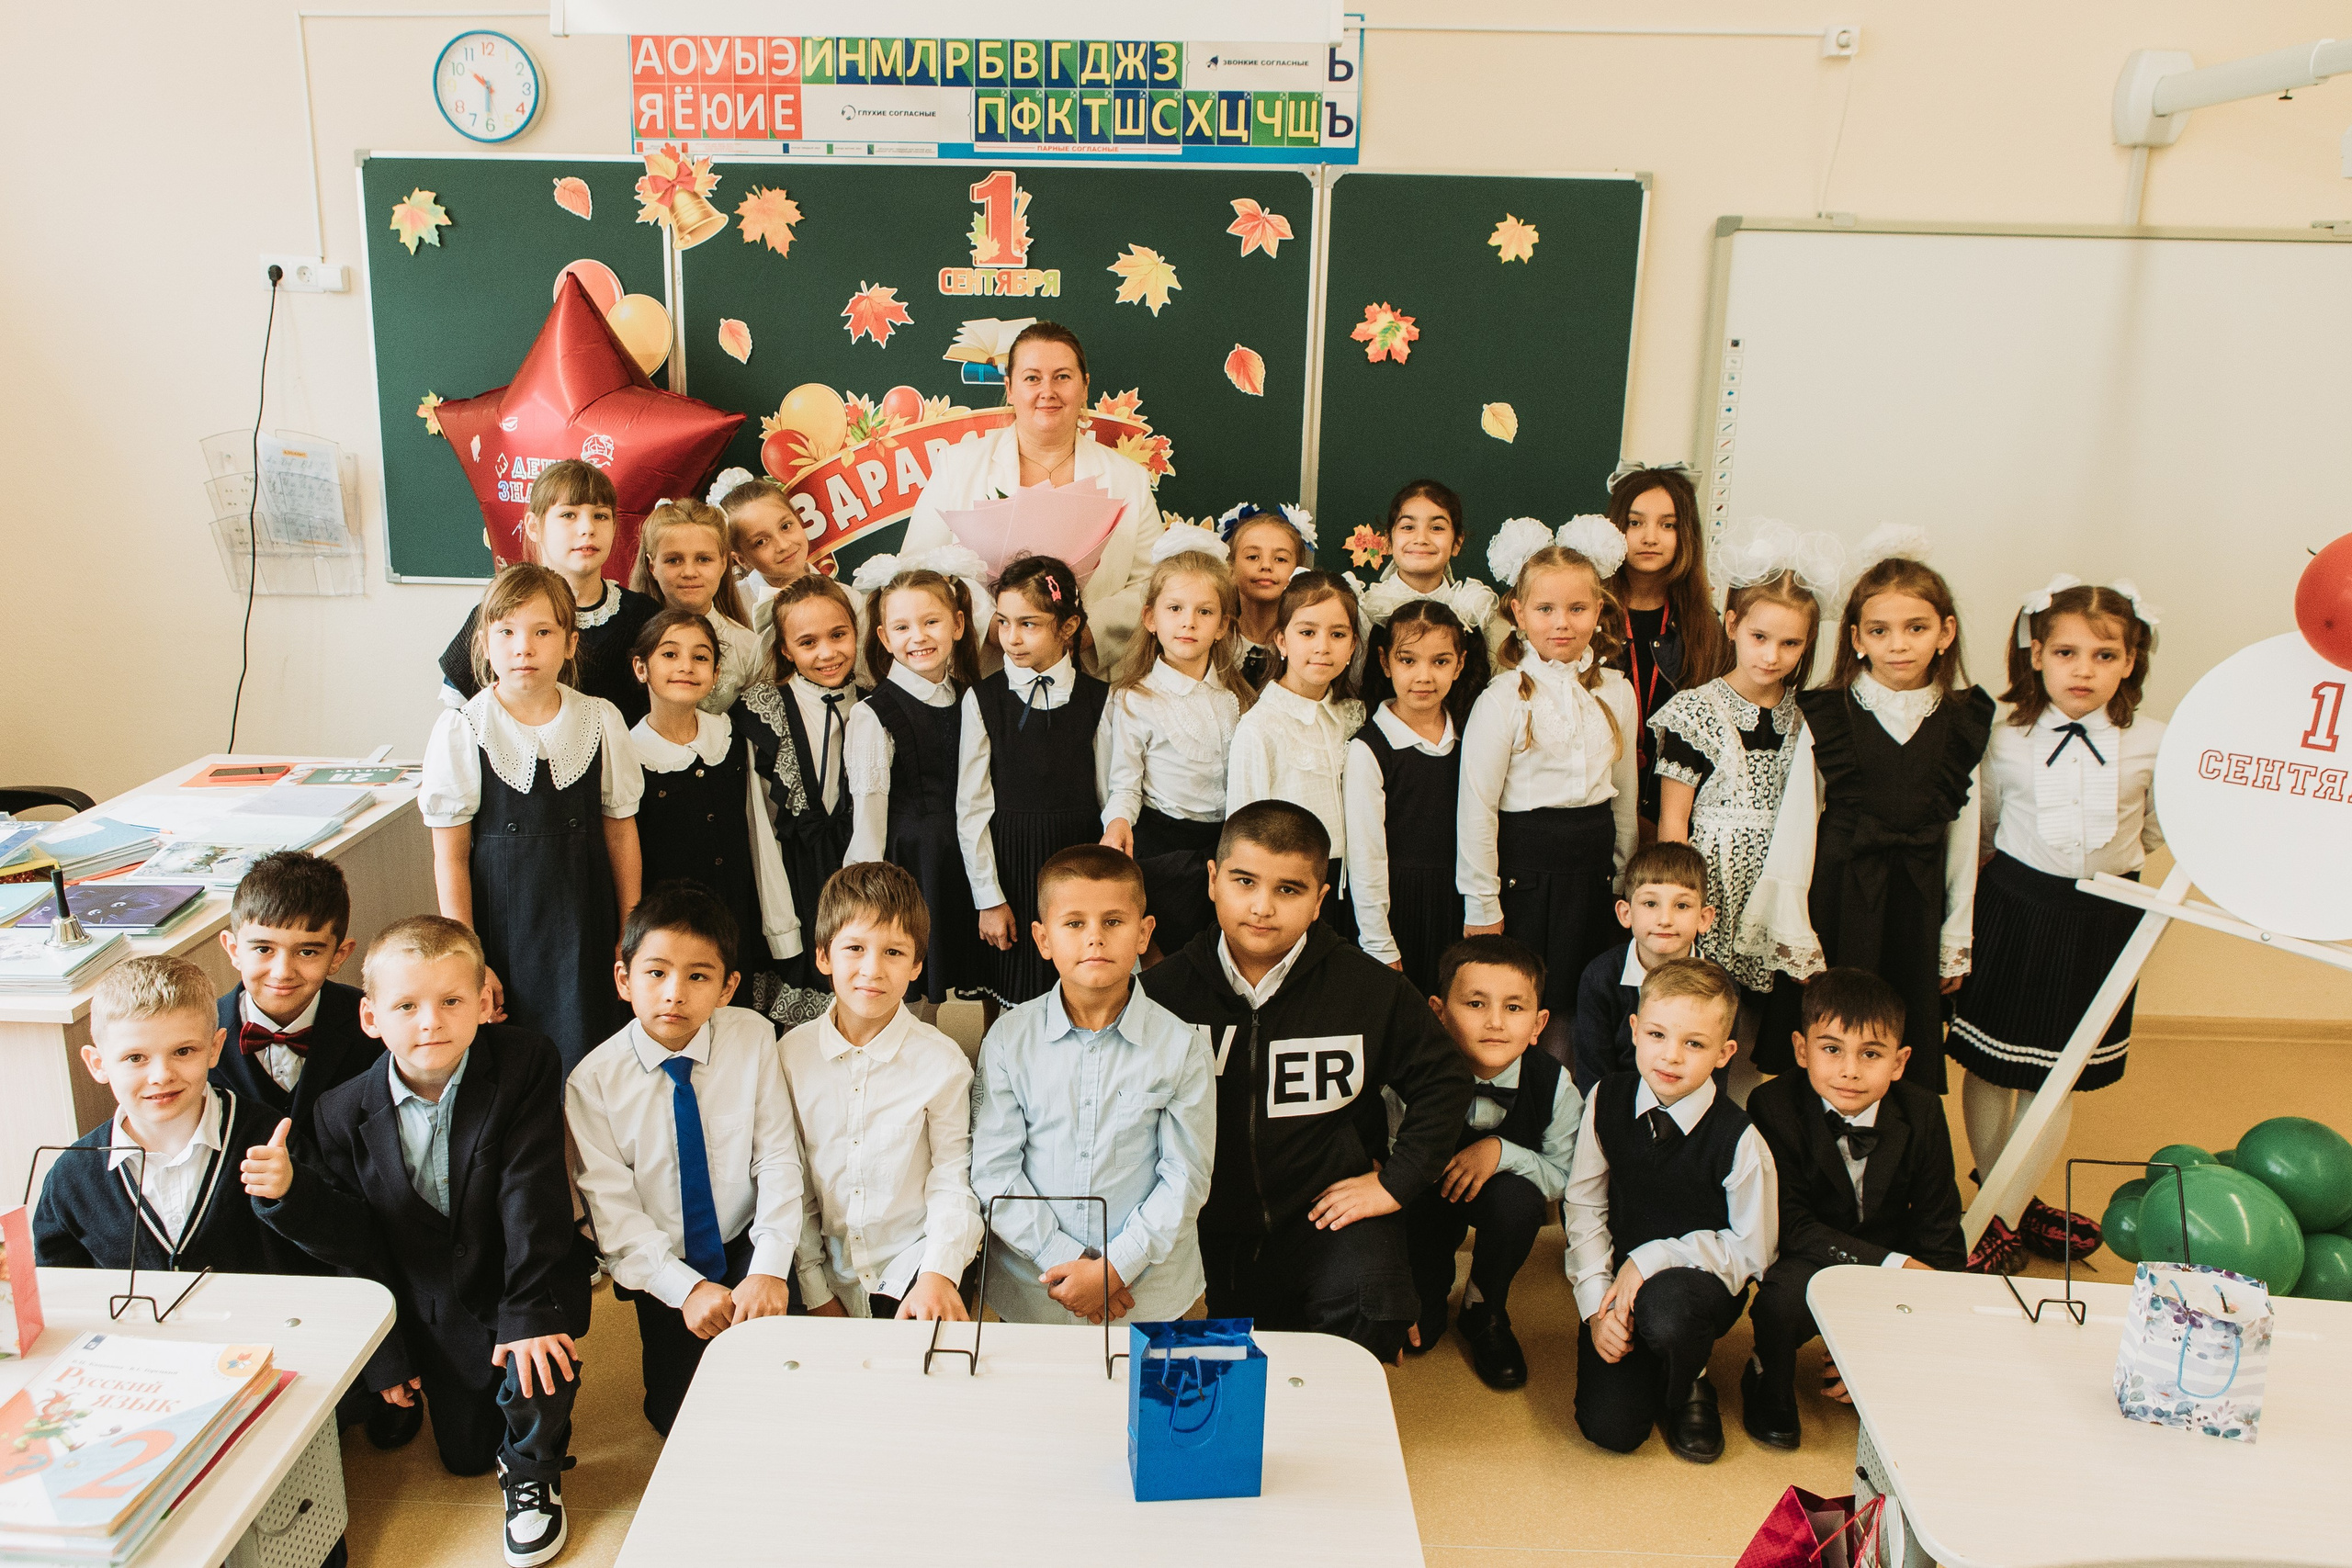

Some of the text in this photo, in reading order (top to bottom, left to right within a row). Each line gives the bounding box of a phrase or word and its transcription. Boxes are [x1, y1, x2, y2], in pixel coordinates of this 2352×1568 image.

[464, 47, 474, 62] 11
[481, 41, 495, 56] 12
[451, 62, 465, 76] 10
[515, 62, 525, 76] 2
[447, 78, 457, 93] 9
[522, 82, 531, 96] 3
[455, 99, 465, 114] 8
[515, 102, 526, 116] 4
[469, 113, 477, 127] 7
[485, 118, 495, 132] 6
[503, 115, 514, 128] 5
[970, 171, 1028, 268] 1
[938, 267, 1061, 298] СЕНТЯБРЯ
[2301, 681, 2346, 752] 1
[2198, 749, 2352, 805] СЕНТЯ
[1273, 1049, 1355, 1105] ER
[53, 1365, 165, 1394] Русский
[57, 1429, 177, 1499] 2
